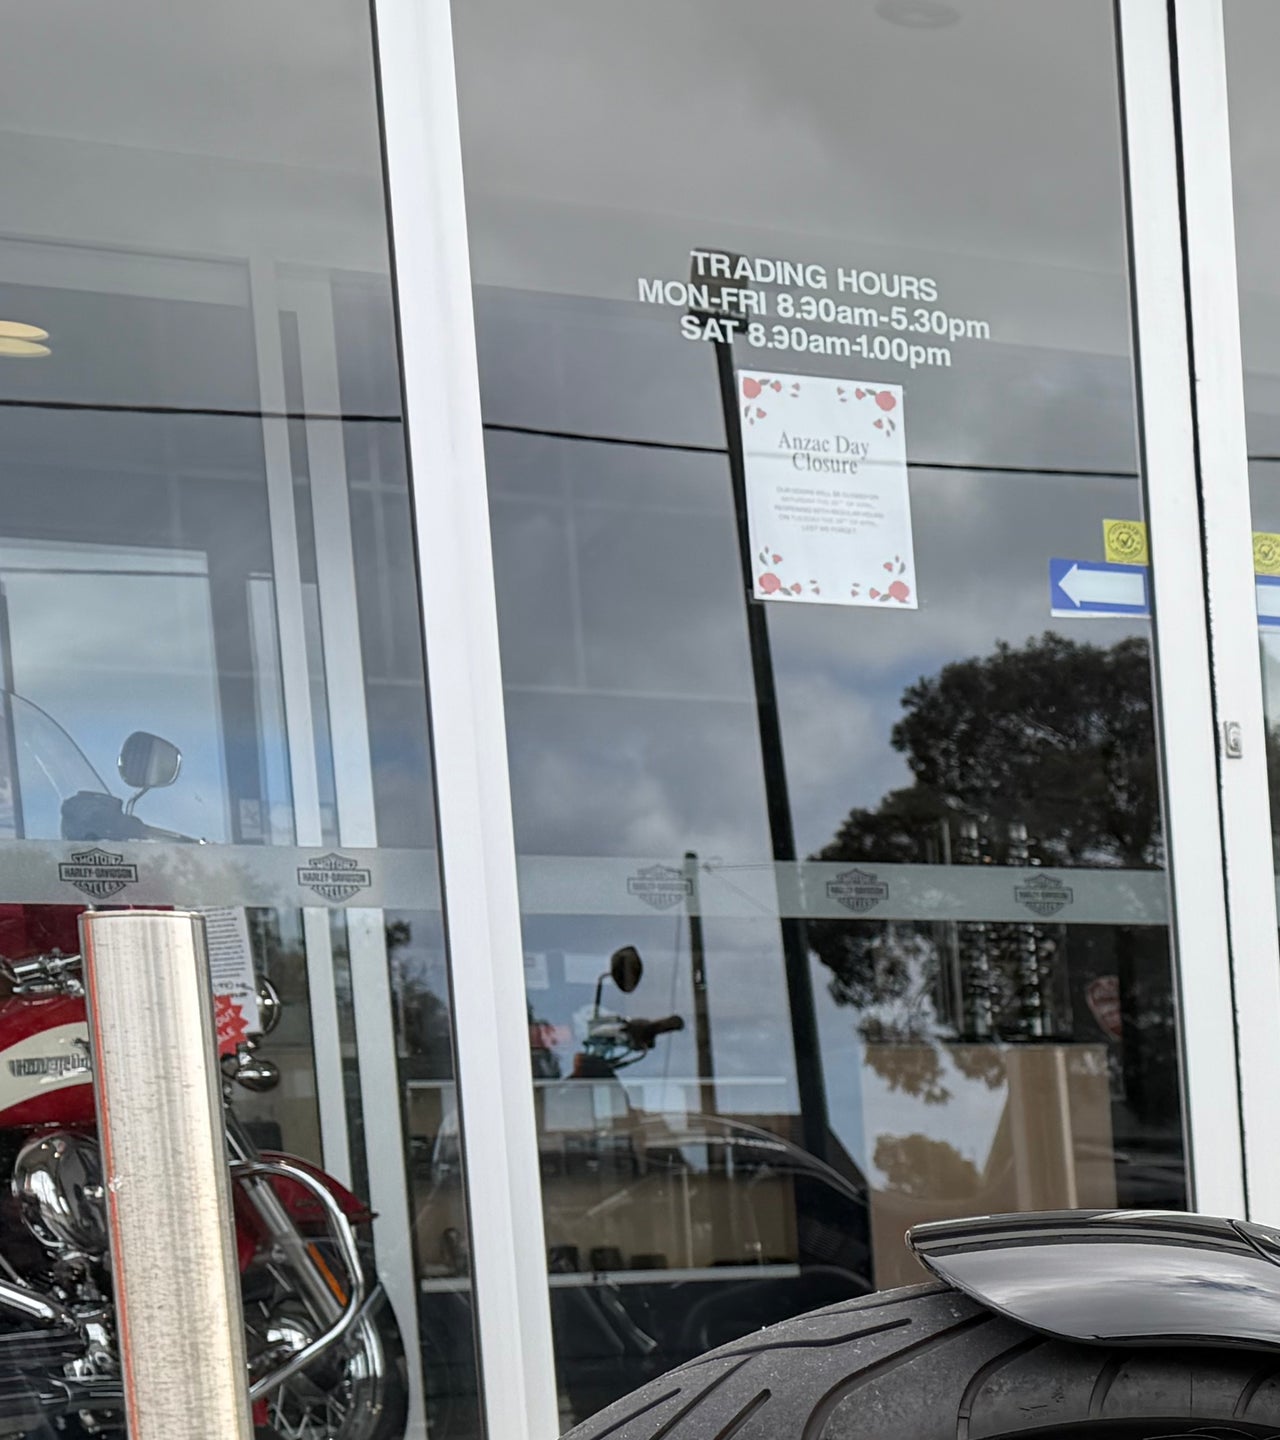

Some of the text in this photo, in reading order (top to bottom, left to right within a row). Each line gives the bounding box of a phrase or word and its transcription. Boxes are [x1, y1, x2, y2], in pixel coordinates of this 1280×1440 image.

[690, 250, 938, 302] TRADING HOURS
[637, 277, 768, 316] MON-FRI
[680, 315, 739, 345] SAT
[778, 431, 870, 461] Anzac Day
[792, 451, 858, 475] Closure
